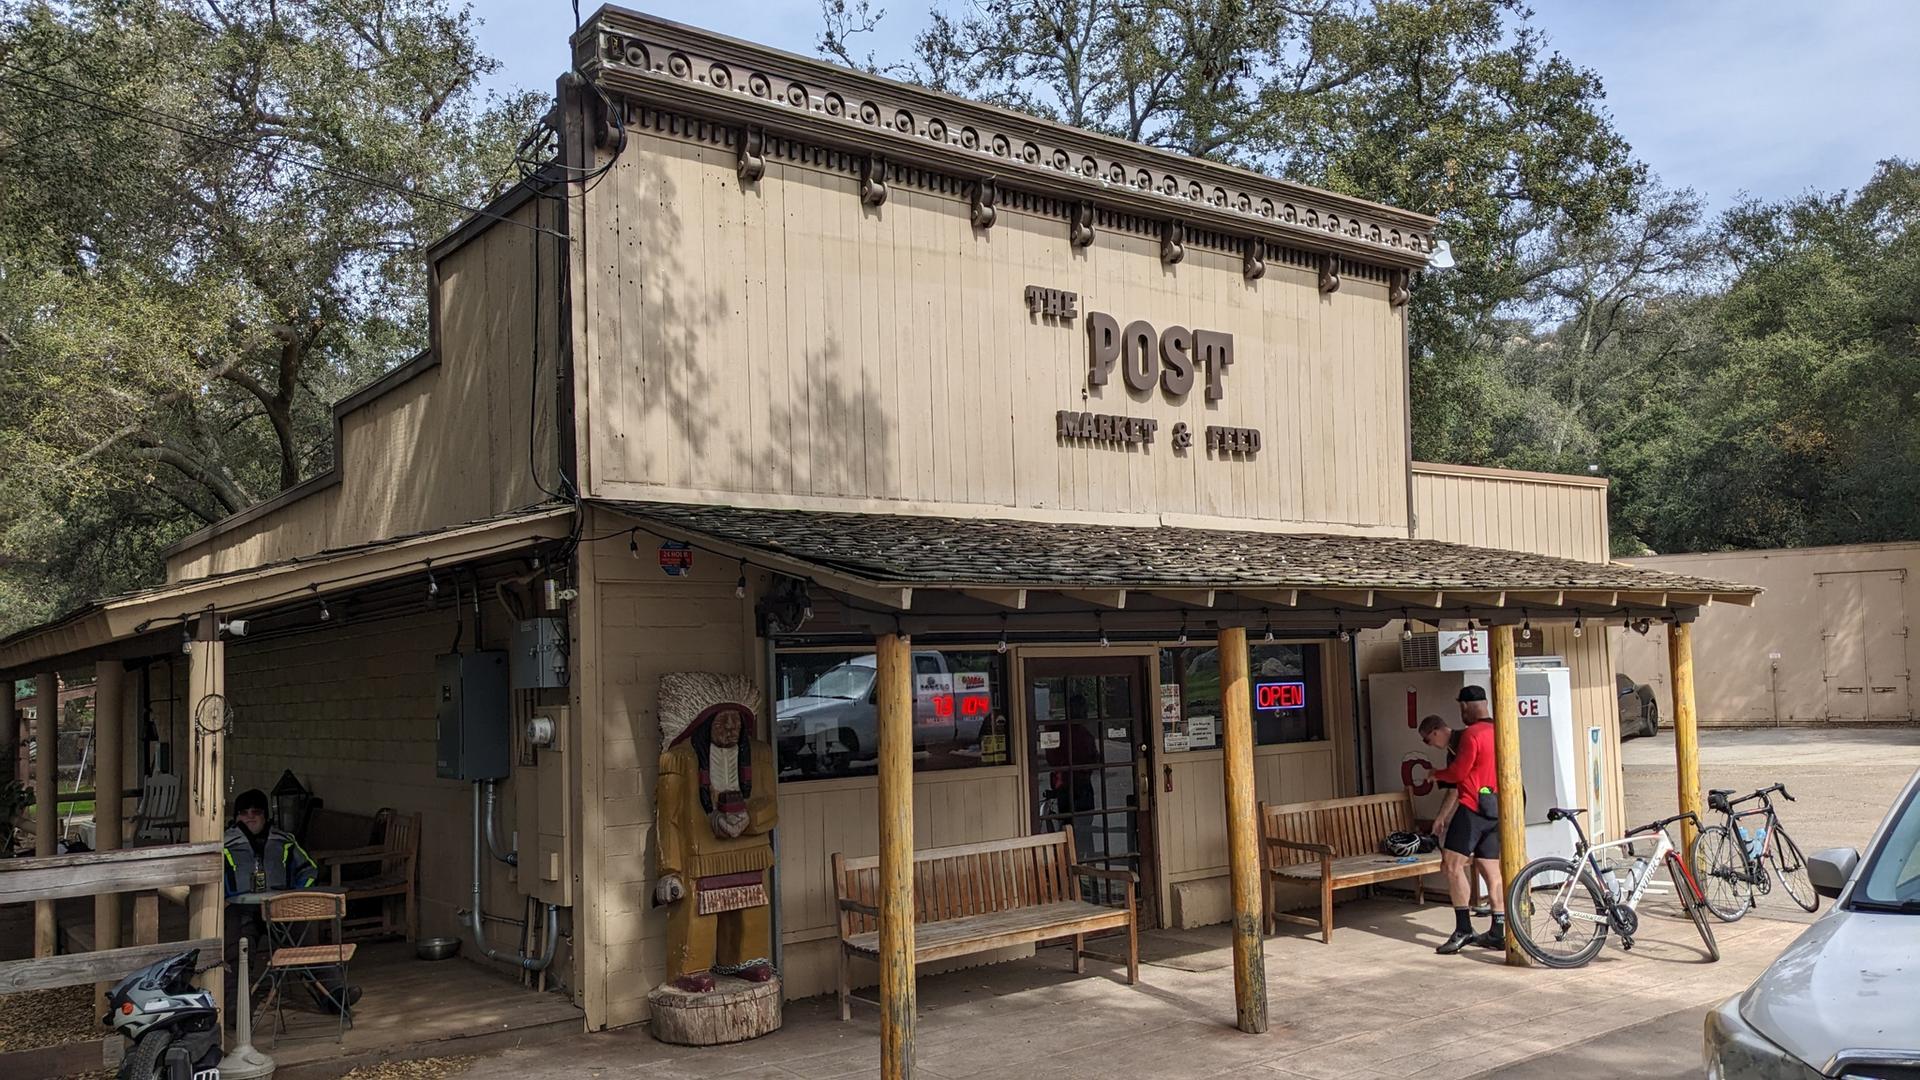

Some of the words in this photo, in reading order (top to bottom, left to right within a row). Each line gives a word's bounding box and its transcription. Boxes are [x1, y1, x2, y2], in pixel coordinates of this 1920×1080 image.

[1025, 285, 1078, 320] THE
[1086, 311, 1234, 400] POST
[1056, 409, 1158, 445] MARKET
[1172, 422, 1192, 450] &
[1205, 425, 1261, 453] FEED
[1259, 685, 1302, 707] OPEN
[1518, 699, 1540, 716] CE
